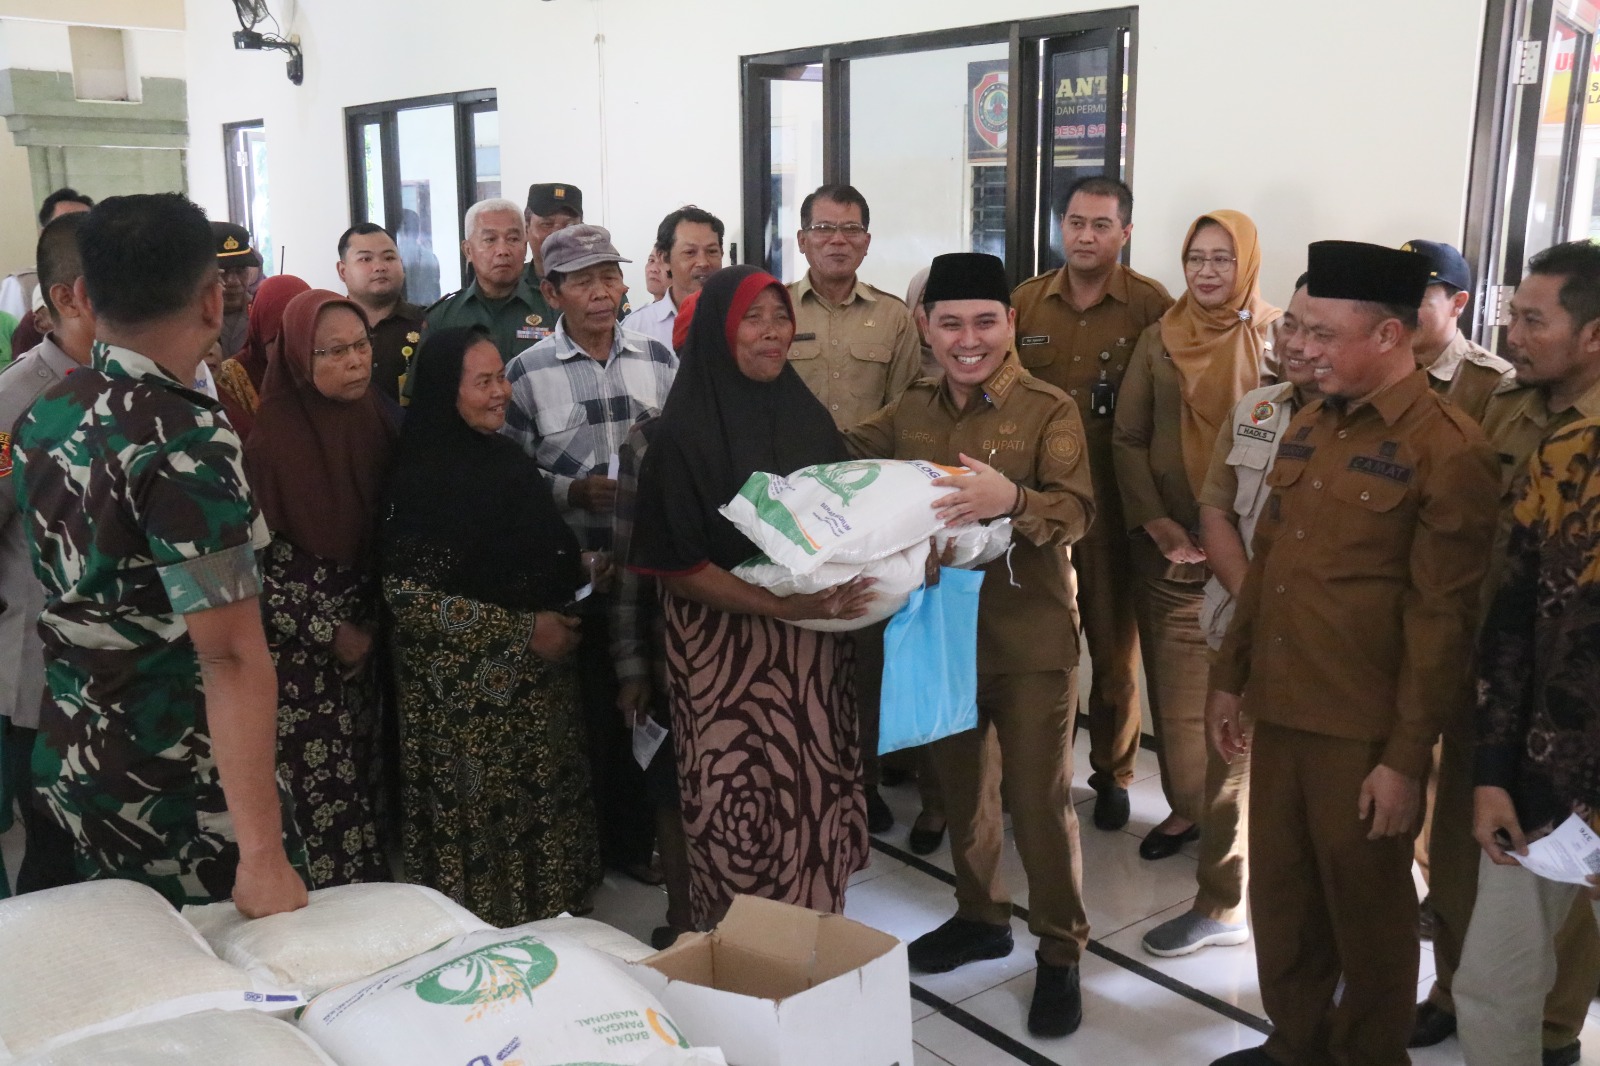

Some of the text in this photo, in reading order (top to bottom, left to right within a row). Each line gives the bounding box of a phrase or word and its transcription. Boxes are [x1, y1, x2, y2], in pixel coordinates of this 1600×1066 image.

[1055, 75, 1107, 98] ANT
[1055, 104, 1107, 115] DAN PERMU
[1087, 123, 1106, 137] SA
[982, 440, 1025, 450] BUPATI
[574, 1010, 639, 1027] NASIONAL
[592, 1019, 645, 1035] PANGAN
[606, 1031, 650, 1046] BADAN
